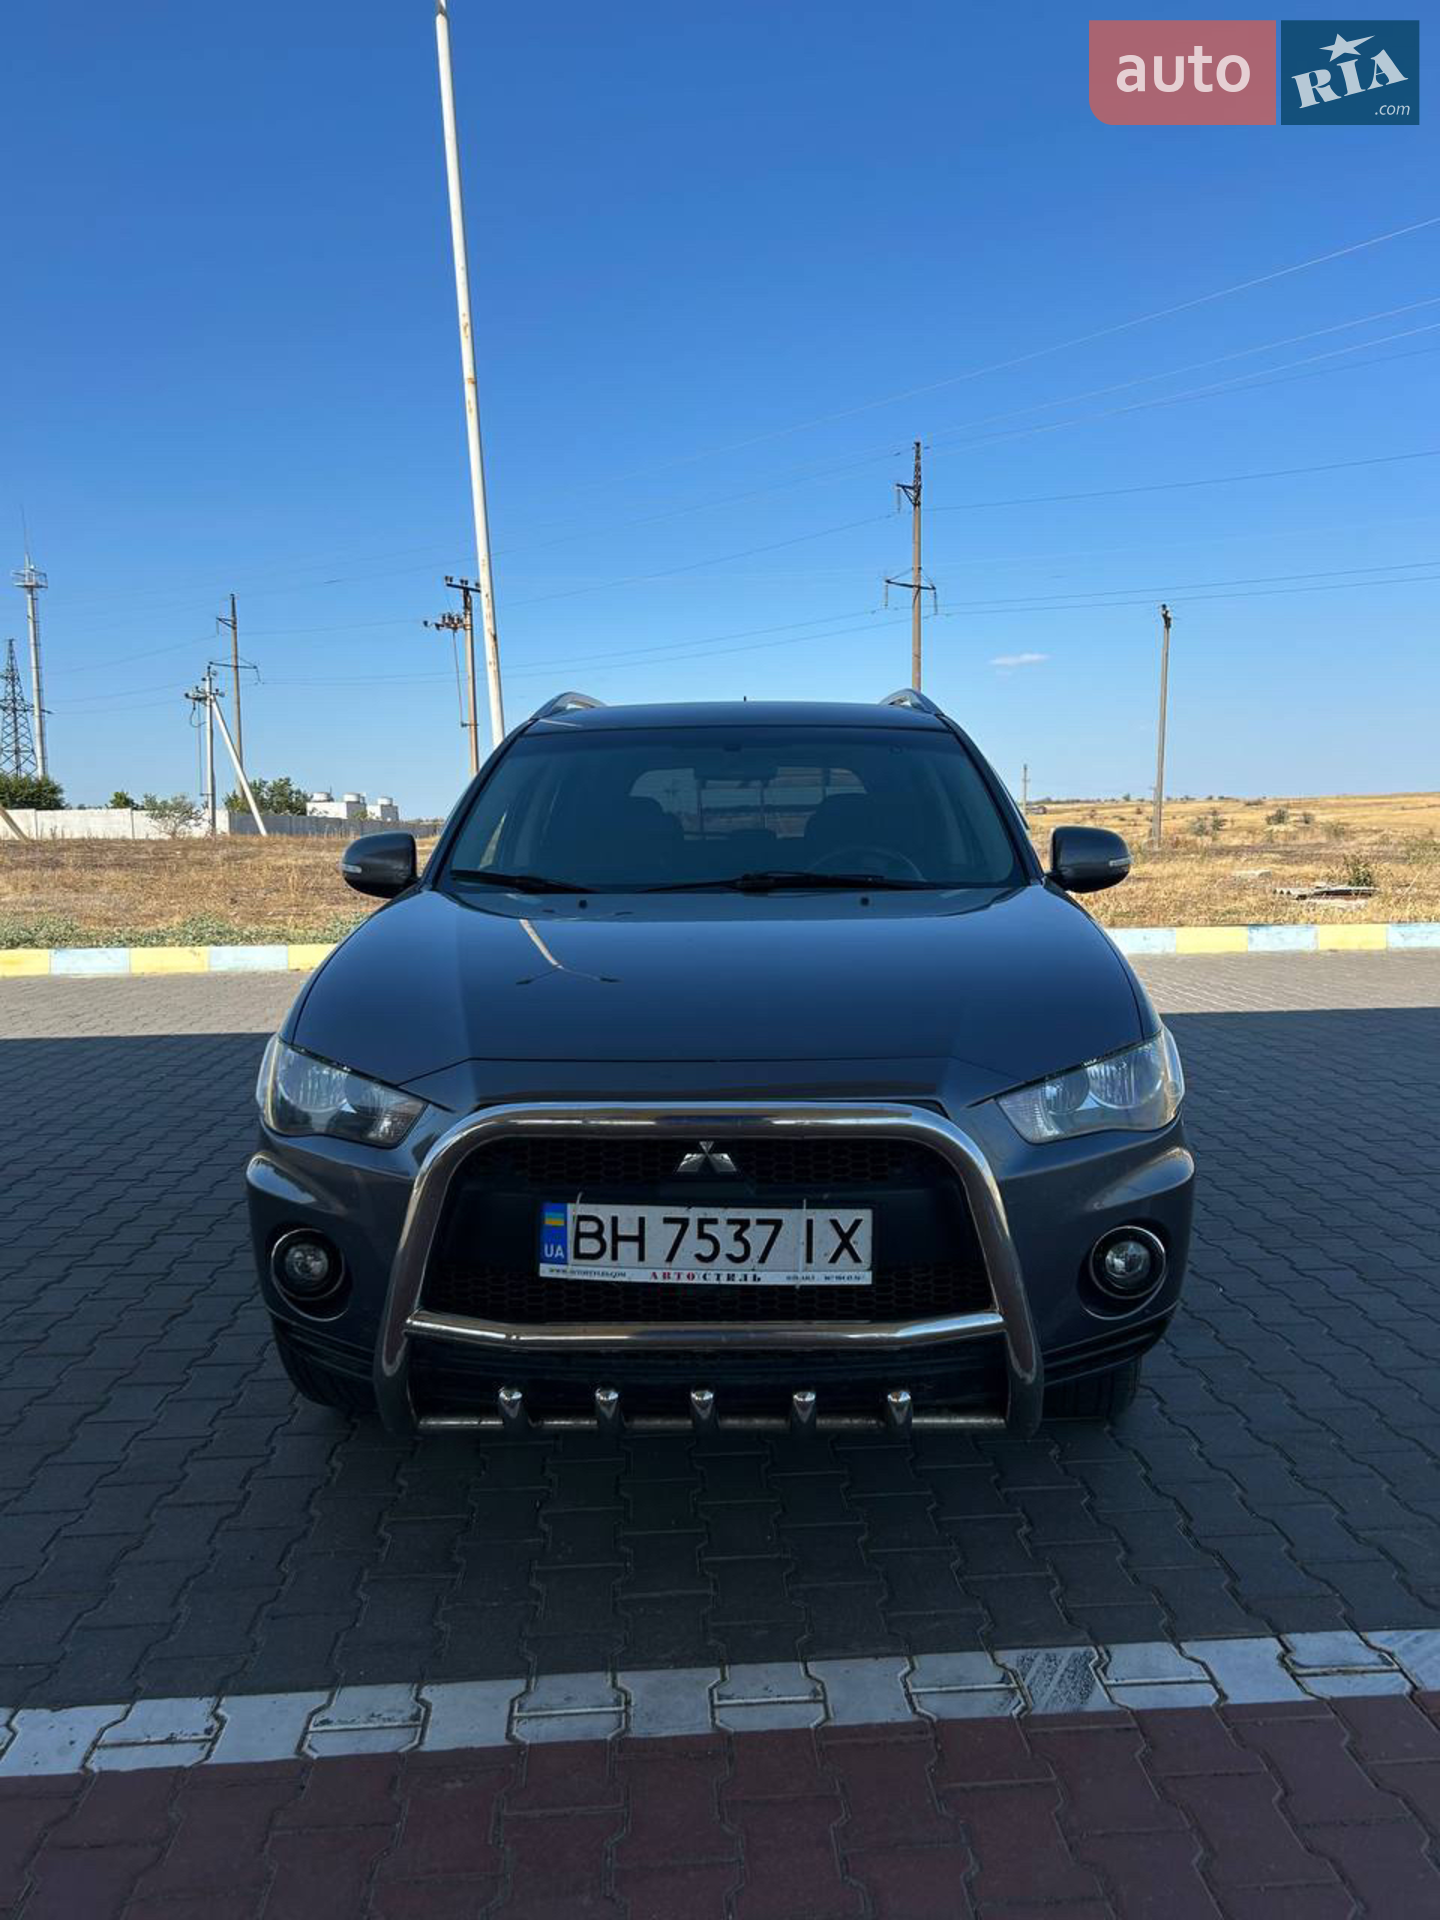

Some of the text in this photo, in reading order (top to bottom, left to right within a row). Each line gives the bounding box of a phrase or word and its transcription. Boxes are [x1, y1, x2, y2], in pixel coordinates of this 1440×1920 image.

[544, 1245, 565, 1258] UA
[573, 1214, 864, 1264] BH 7537 IX
